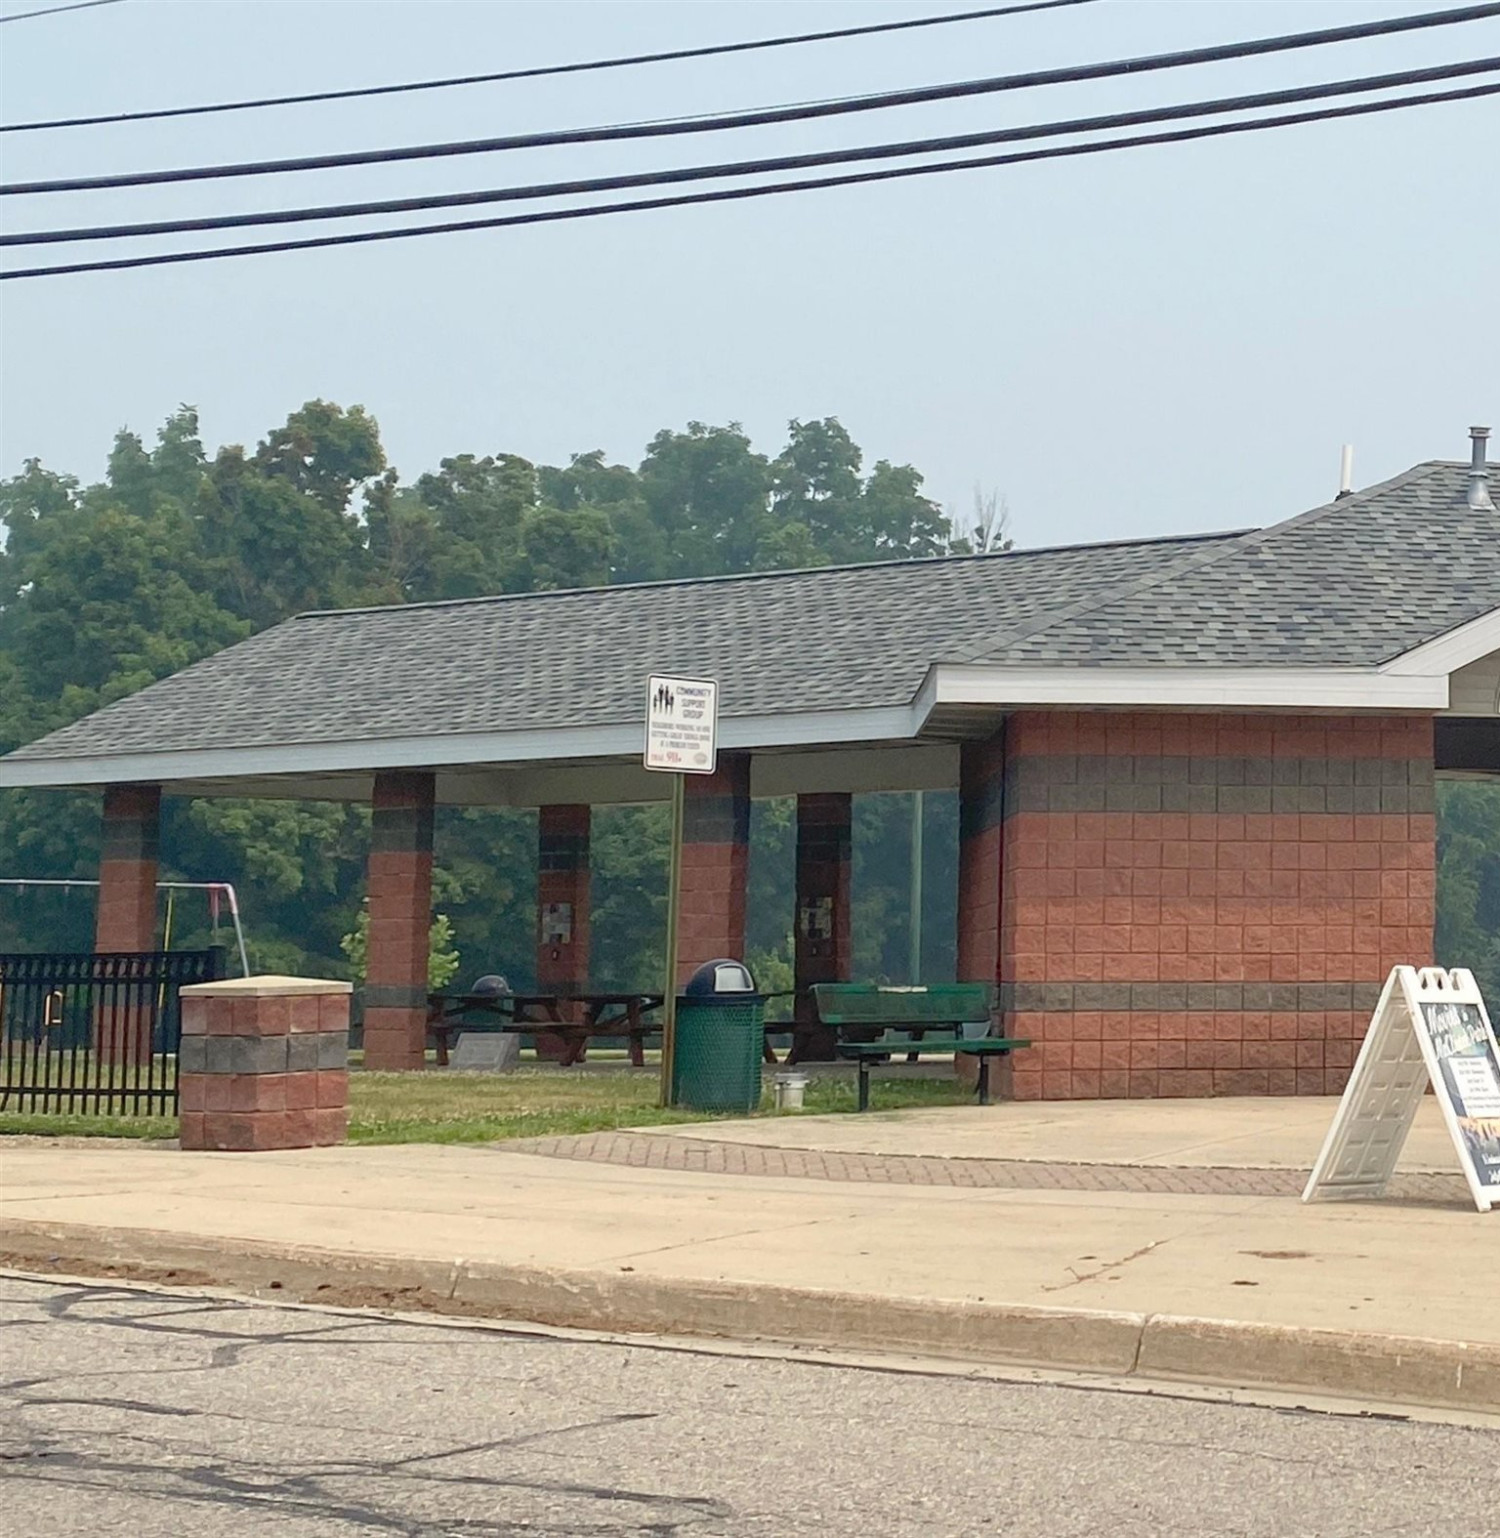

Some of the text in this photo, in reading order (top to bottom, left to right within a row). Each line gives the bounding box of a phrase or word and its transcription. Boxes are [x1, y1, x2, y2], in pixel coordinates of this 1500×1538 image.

[676, 686, 711, 696] COMMUNITY
[682, 699, 705, 708] SUPPORT
[683, 710, 703, 719] GROUP
